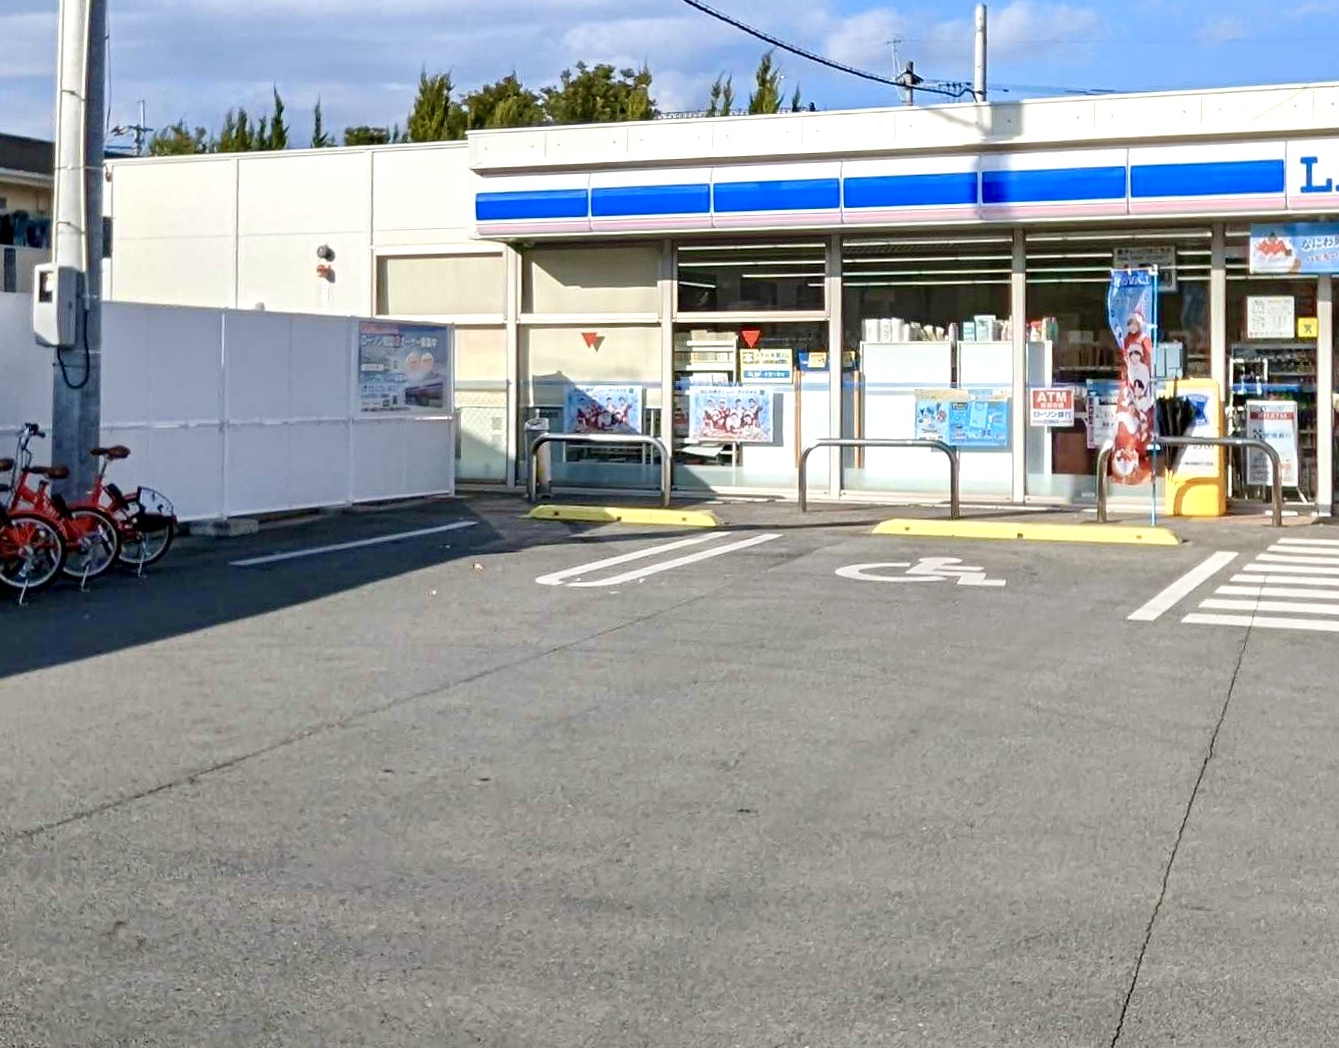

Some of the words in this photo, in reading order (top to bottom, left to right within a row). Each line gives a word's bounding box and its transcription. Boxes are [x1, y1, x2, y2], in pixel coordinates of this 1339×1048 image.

[1037, 392, 1067, 403] ATM
[1033, 411, 1071, 419] ローソン銀行
